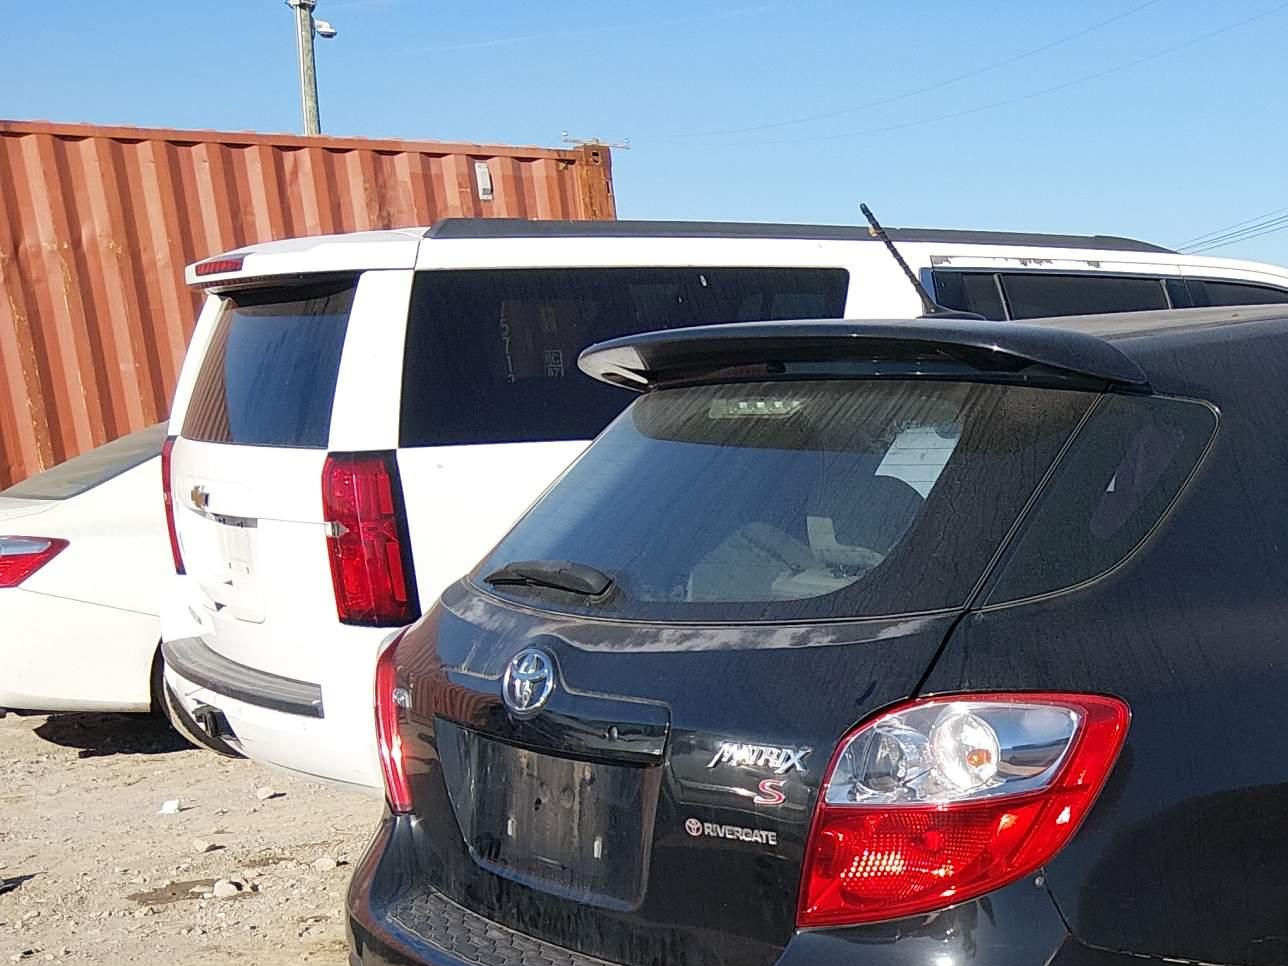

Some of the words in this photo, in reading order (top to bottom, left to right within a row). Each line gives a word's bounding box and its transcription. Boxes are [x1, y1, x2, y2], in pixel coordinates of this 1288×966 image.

[706, 741, 813, 774] MATRIX
[752, 778, 787, 806] S
[703, 822, 777, 845] RIVERGATE
